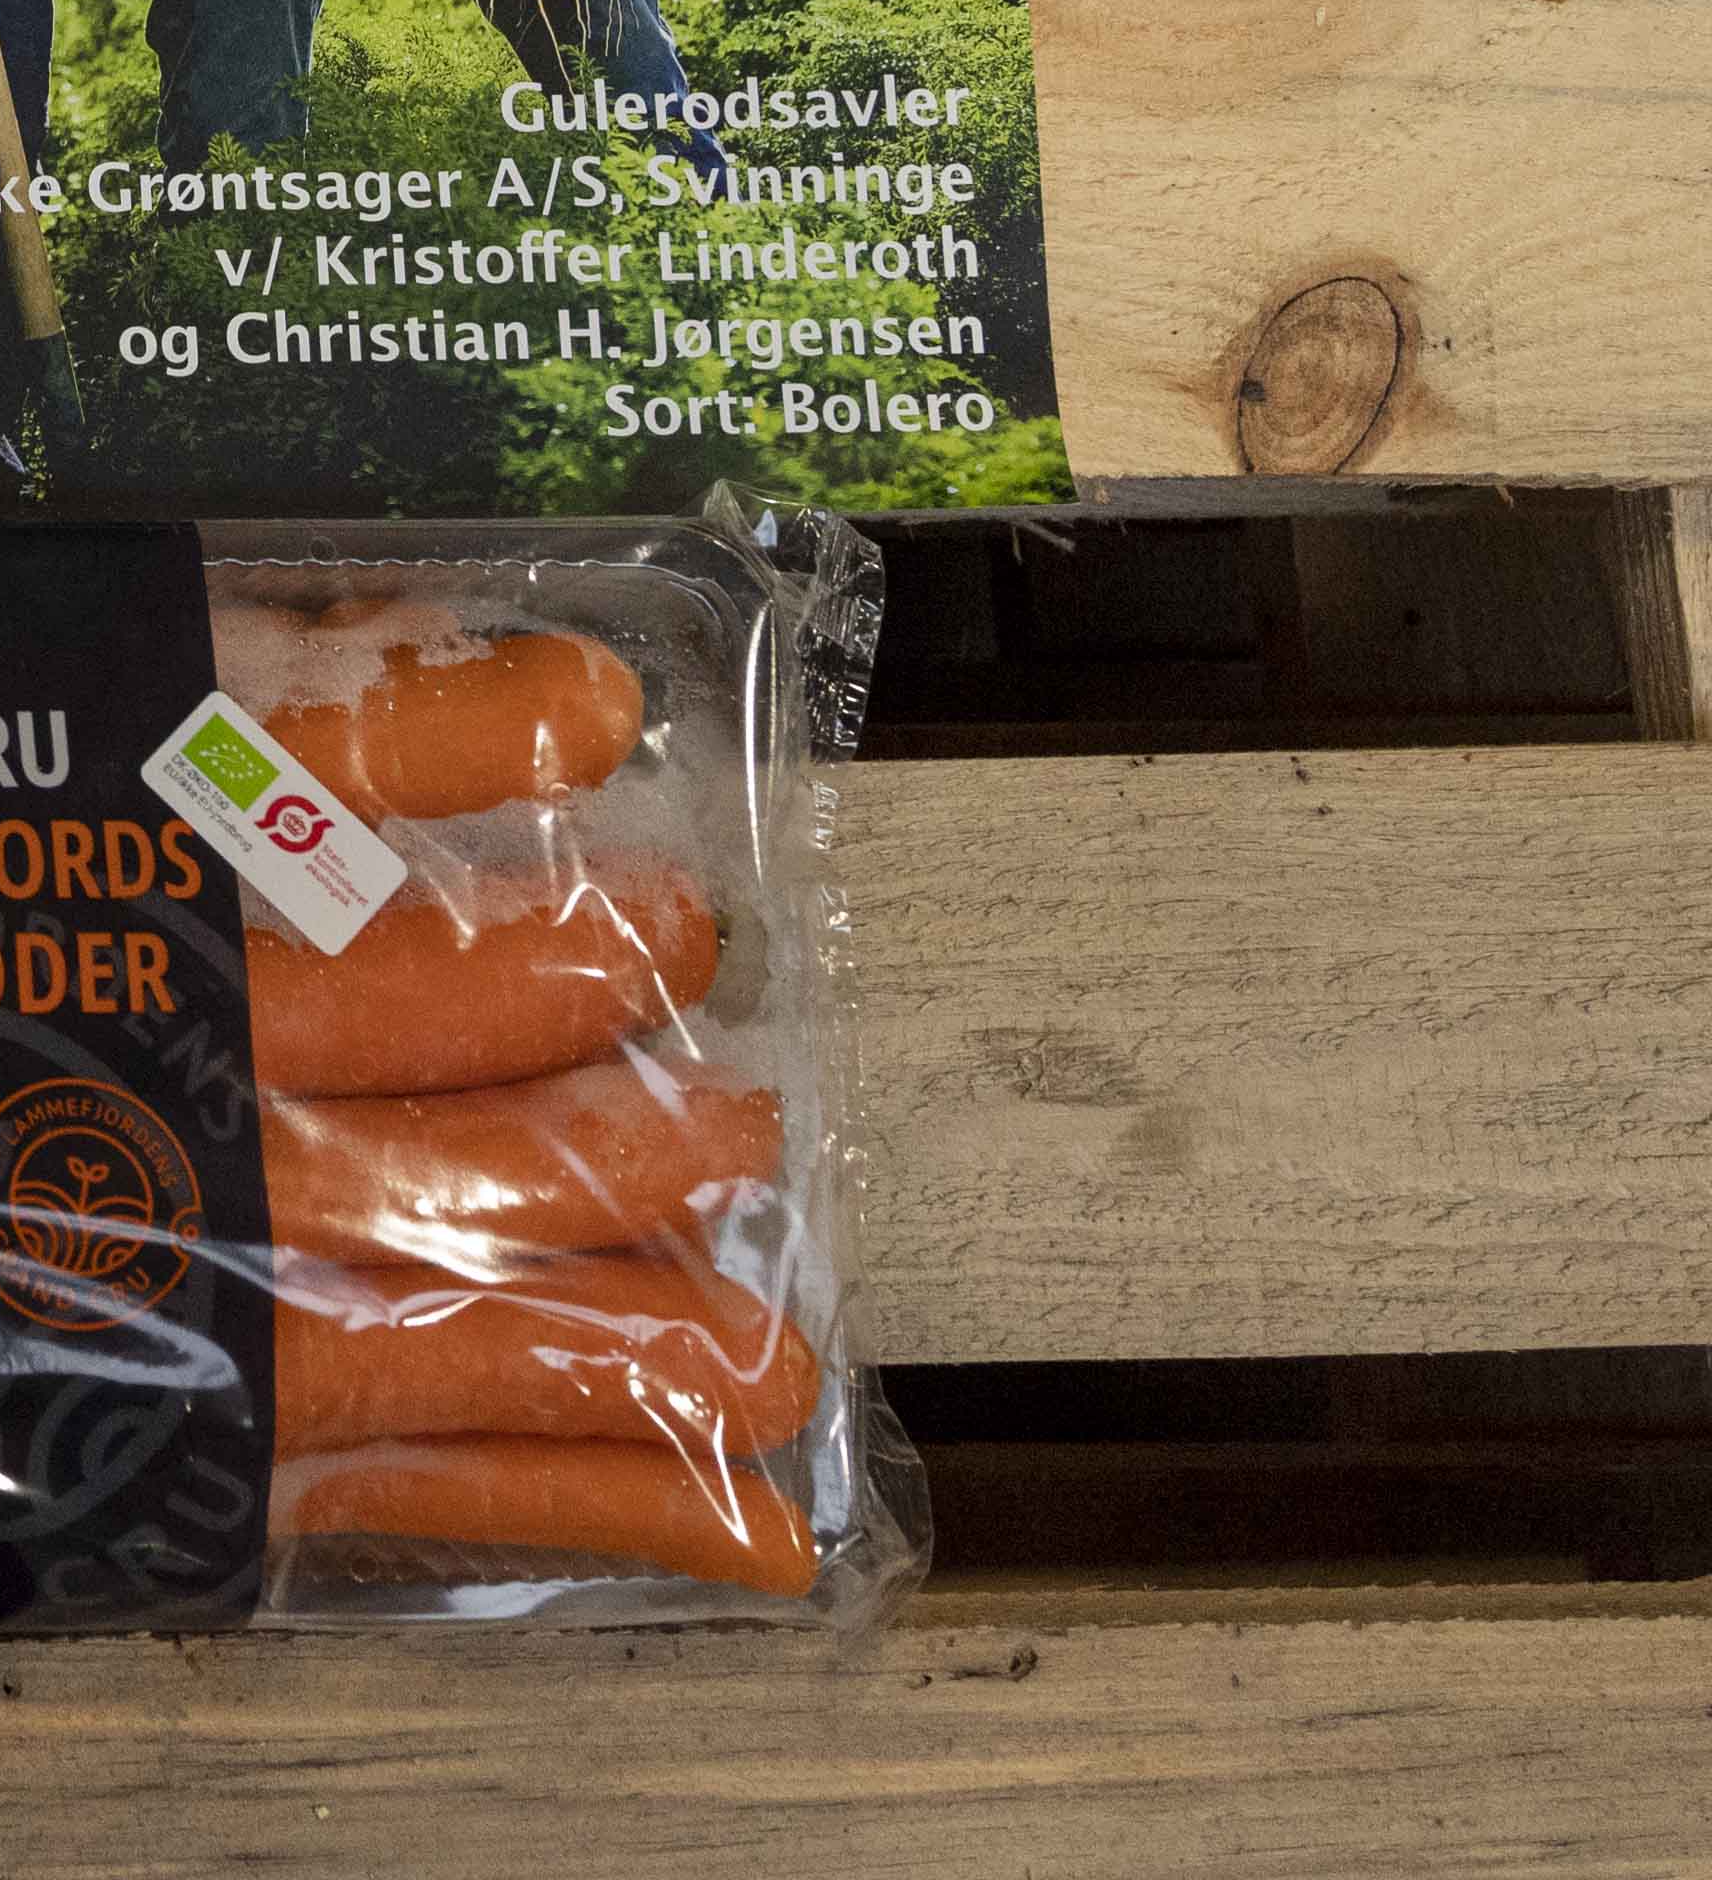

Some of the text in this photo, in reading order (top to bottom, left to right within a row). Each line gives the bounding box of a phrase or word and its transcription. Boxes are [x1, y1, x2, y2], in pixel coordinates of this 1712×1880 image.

[500, 74, 970, 134] Gulerodsavler
[88, 160, 462, 222] Grøntsager
[486, 155, 625, 217] A/S,
[648, 153, 975, 216] Svinninge
[214, 224, 979, 295] v/ Kristoffer Linderoth
[118, 306, 985, 378] og Christian H. Jørgensen
[604, 379, 996, 437] Sort: Bolero
[1, 1096, 178, 1189] LAMMEFJORDENS
